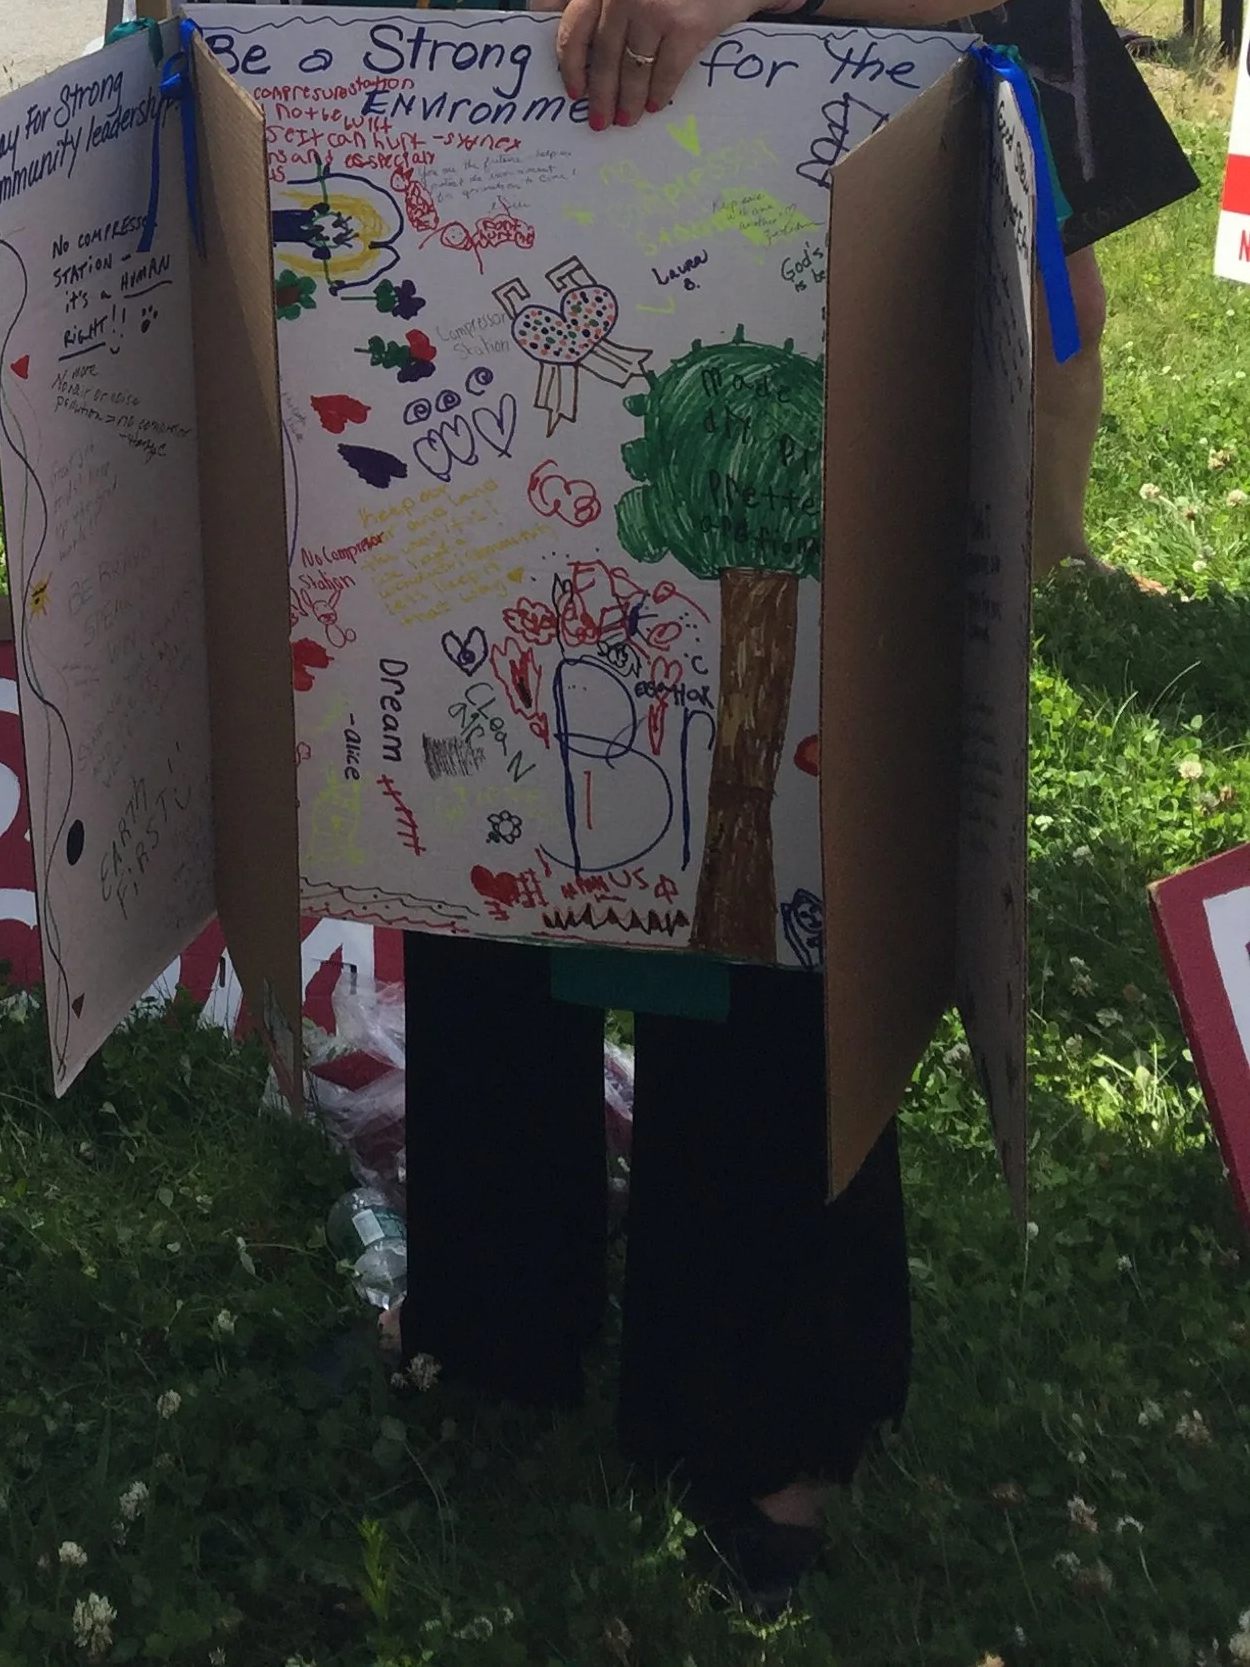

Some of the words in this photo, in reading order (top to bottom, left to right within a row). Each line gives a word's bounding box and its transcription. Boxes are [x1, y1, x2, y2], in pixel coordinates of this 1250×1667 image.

[204, 33, 271, 76] Be
[297, 48, 334, 74] a
[362, 23, 533, 98] Strong
[700, 39, 799, 89] for
[823, 38, 923, 90] the
[25, 103, 53, 141] For
[53, 70, 125, 127] Strong
[275, 102, 318, 121] not
[327, 132, 366, 150] can
[373, 131, 427, 151] hurt
[51, 233, 70, 261] No
[77, 215, 157, 250] COMPRESS
[779, 241, 826, 281] God's
[65, 289, 89, 314] it's
[100, 290, 113, 301] a
[453, 336, 511, 361] Station
[300, 546, 324, 569] No
[298, 569, 357, 591] Station
[377, 656, 411, 764] Dream
